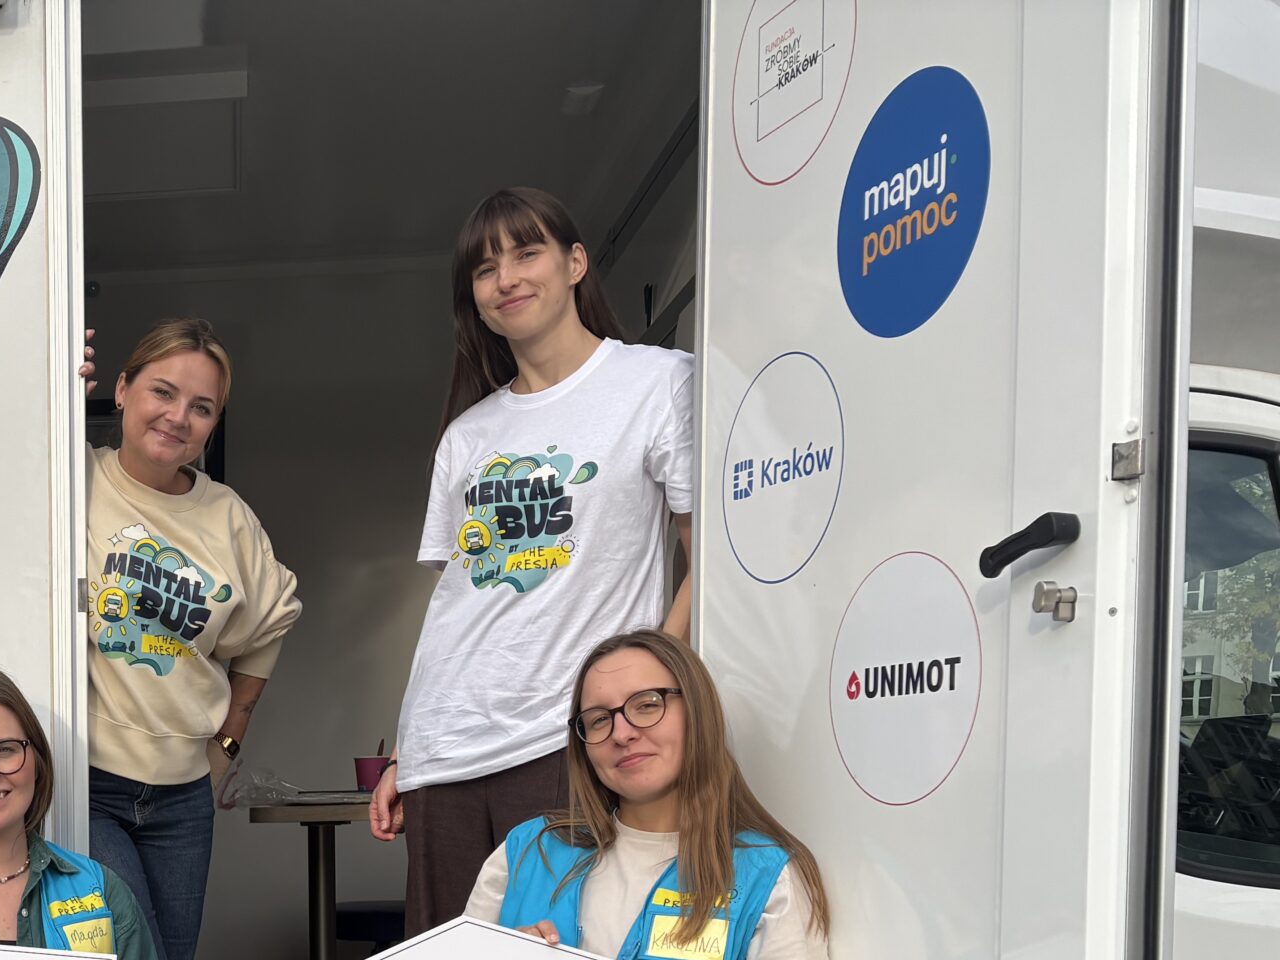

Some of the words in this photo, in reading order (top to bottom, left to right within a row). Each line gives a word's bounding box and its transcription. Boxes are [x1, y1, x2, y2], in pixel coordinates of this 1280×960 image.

[765, 27, 795, 54] FUNDACJA
[765, 34, 801, 72] ZRÓBMY
[778, 50, 800, 76] SOBIE
[778, 50, 819, 89] KRAKÓW
[864, 133, 947, 221] mapuj
[862, 192, 957, 277] pomoc
[761, 441, 833, 488] Kraków
[464, 474, 564, 509] MENTAL
[495, 496, 574, 540] BUS
[510, 558, 558, 572] PRESJA
[522, 546, 545, 558] THE
[104, 553, 206, 606] MENTAL
[135, 585, 212, 641] BUS
[149, 644, 183, 657] PRESJA
[154, 634, 176, 645] THE
[864, 656, 961, 698] UNIMOT
[71, 926, 108, 949] Magda
